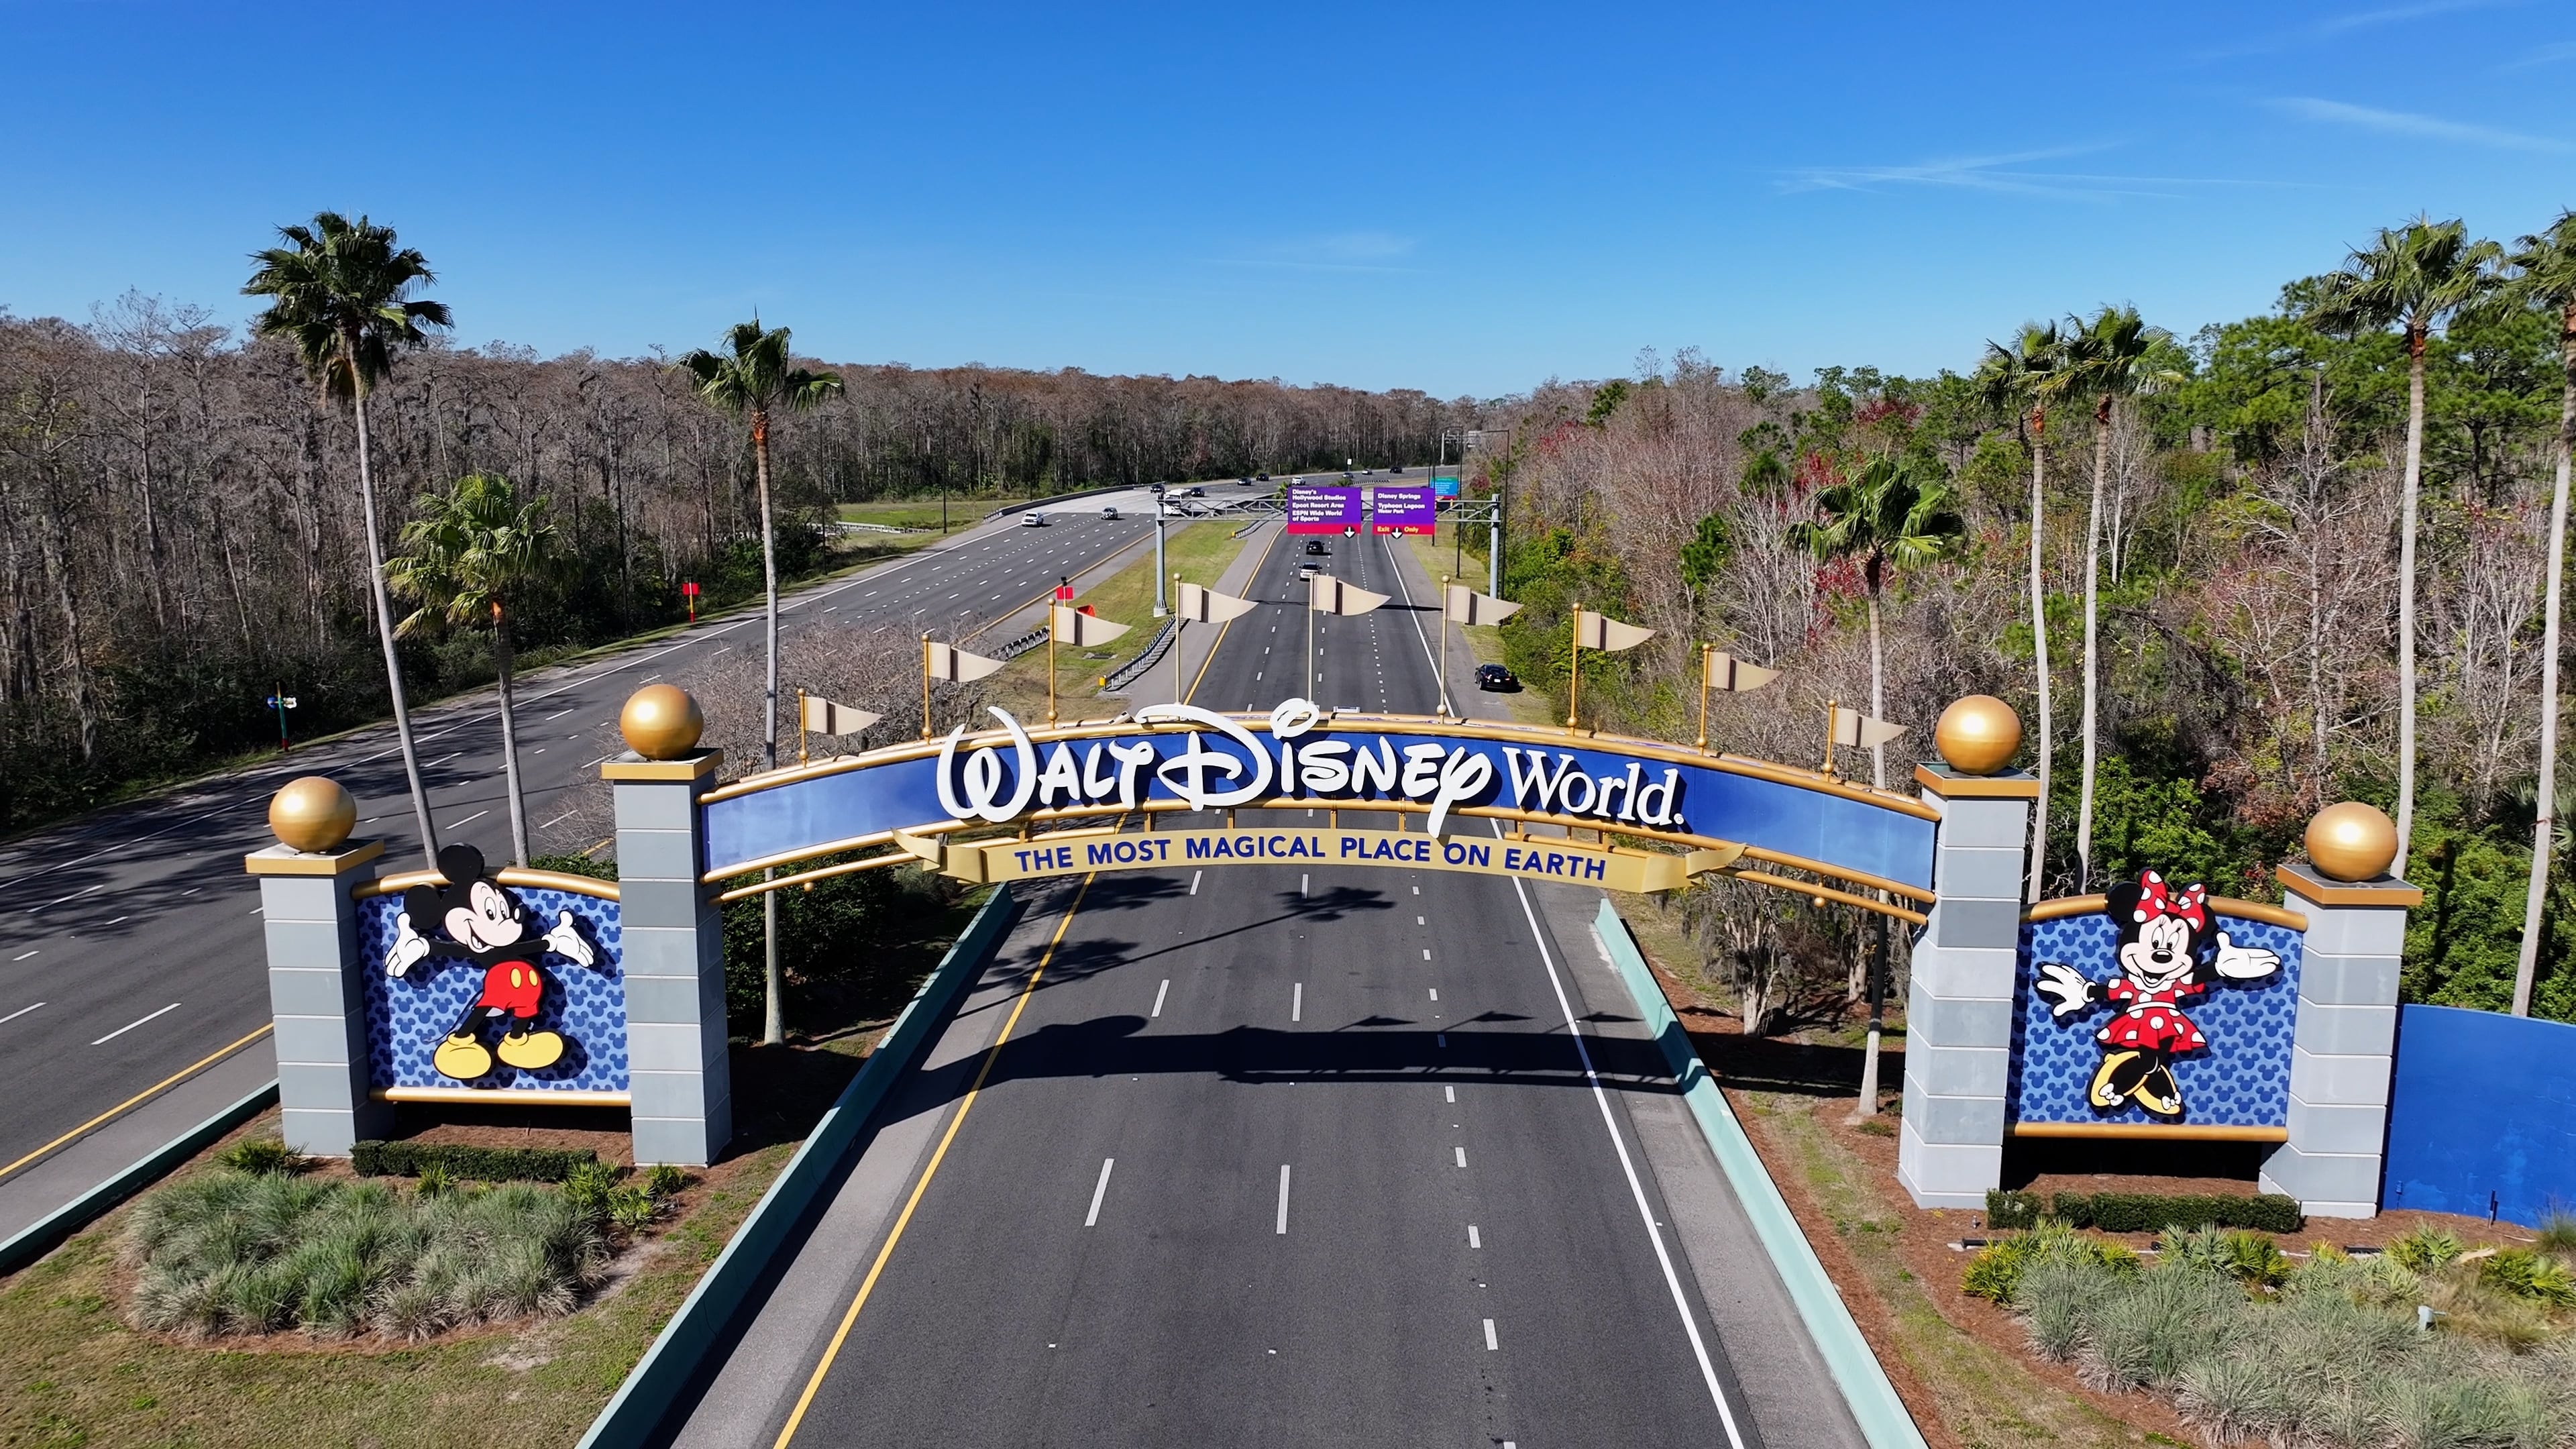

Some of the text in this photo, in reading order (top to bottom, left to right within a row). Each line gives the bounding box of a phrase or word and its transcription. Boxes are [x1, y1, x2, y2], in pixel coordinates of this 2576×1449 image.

[1014, 835, 1606, 881] THE MOST MAGICAL PLACE ON EARTH
